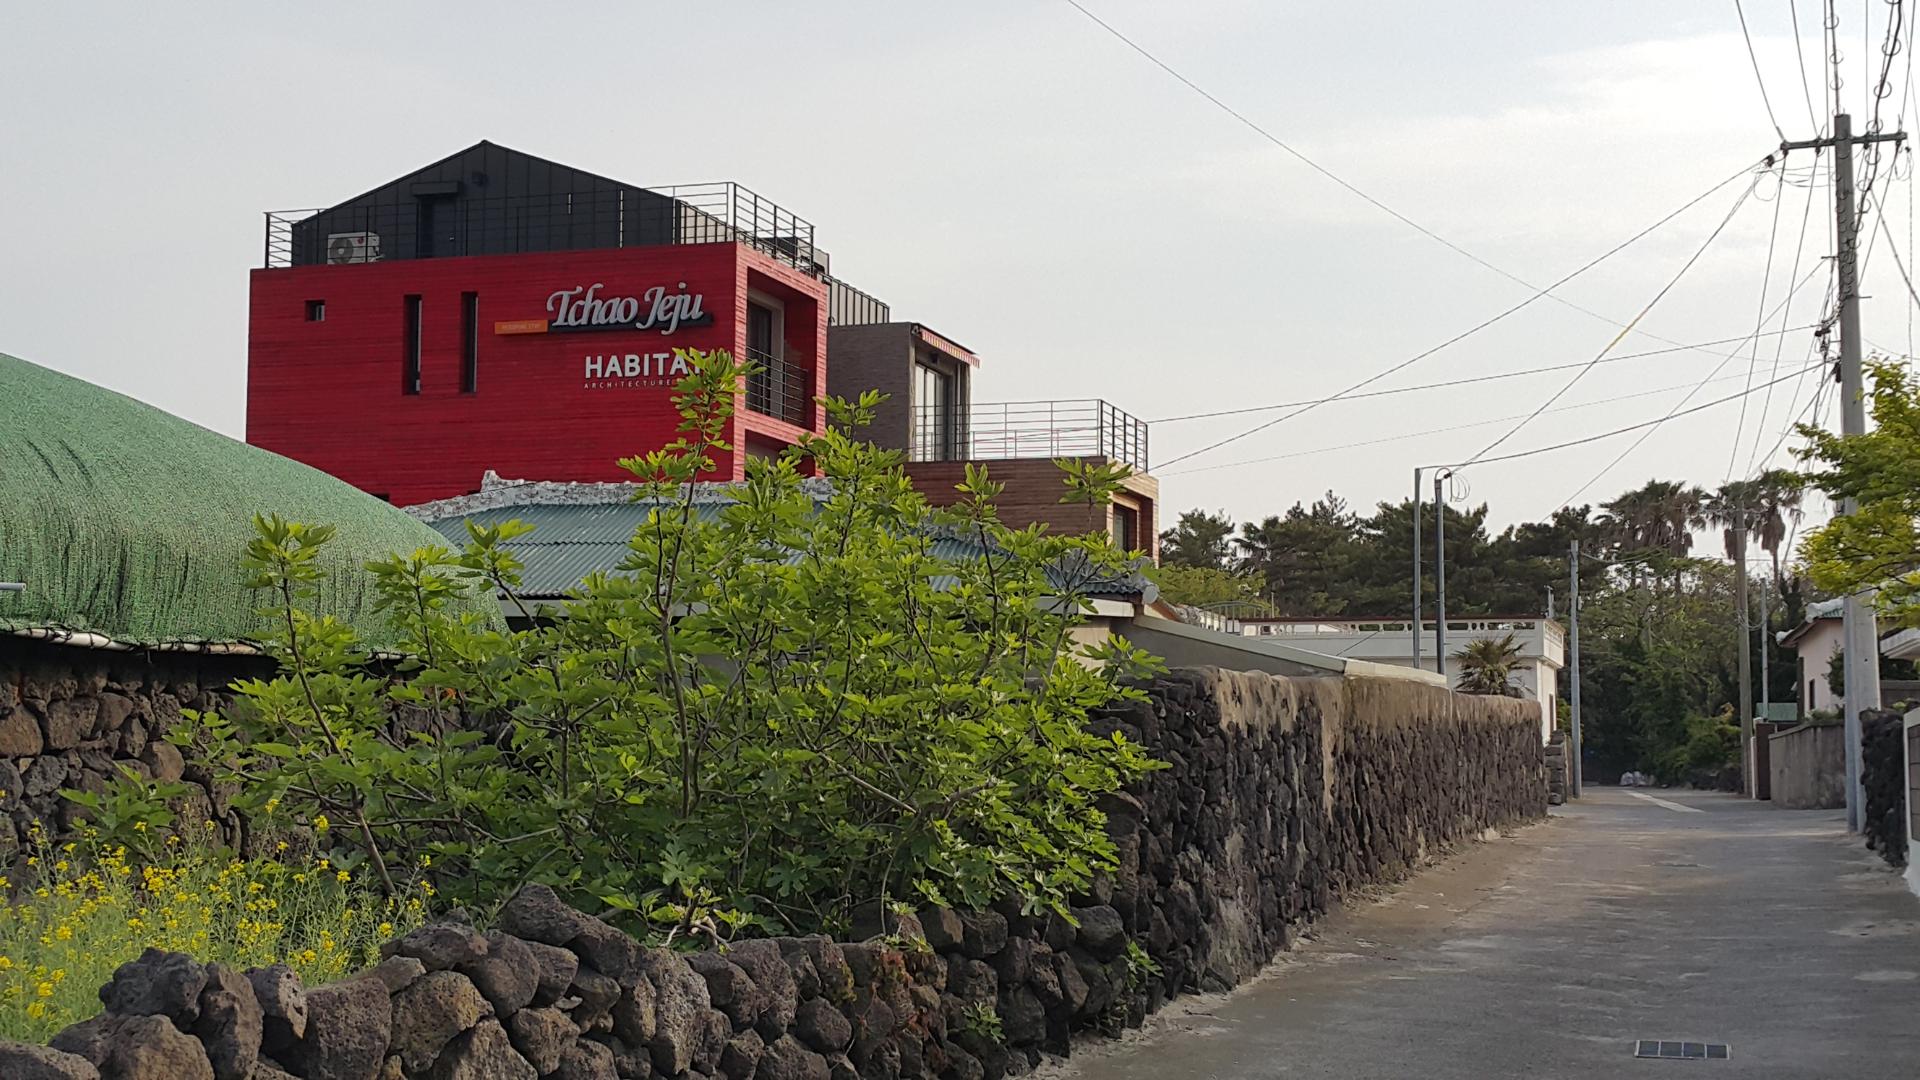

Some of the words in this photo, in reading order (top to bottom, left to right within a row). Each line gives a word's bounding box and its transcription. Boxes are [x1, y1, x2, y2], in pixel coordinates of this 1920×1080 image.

[547, 283, 638, 327] Tchao
[636, 282, 703, 335] Jeju
[584, 379, 672, 389] ARCHITECTURE
